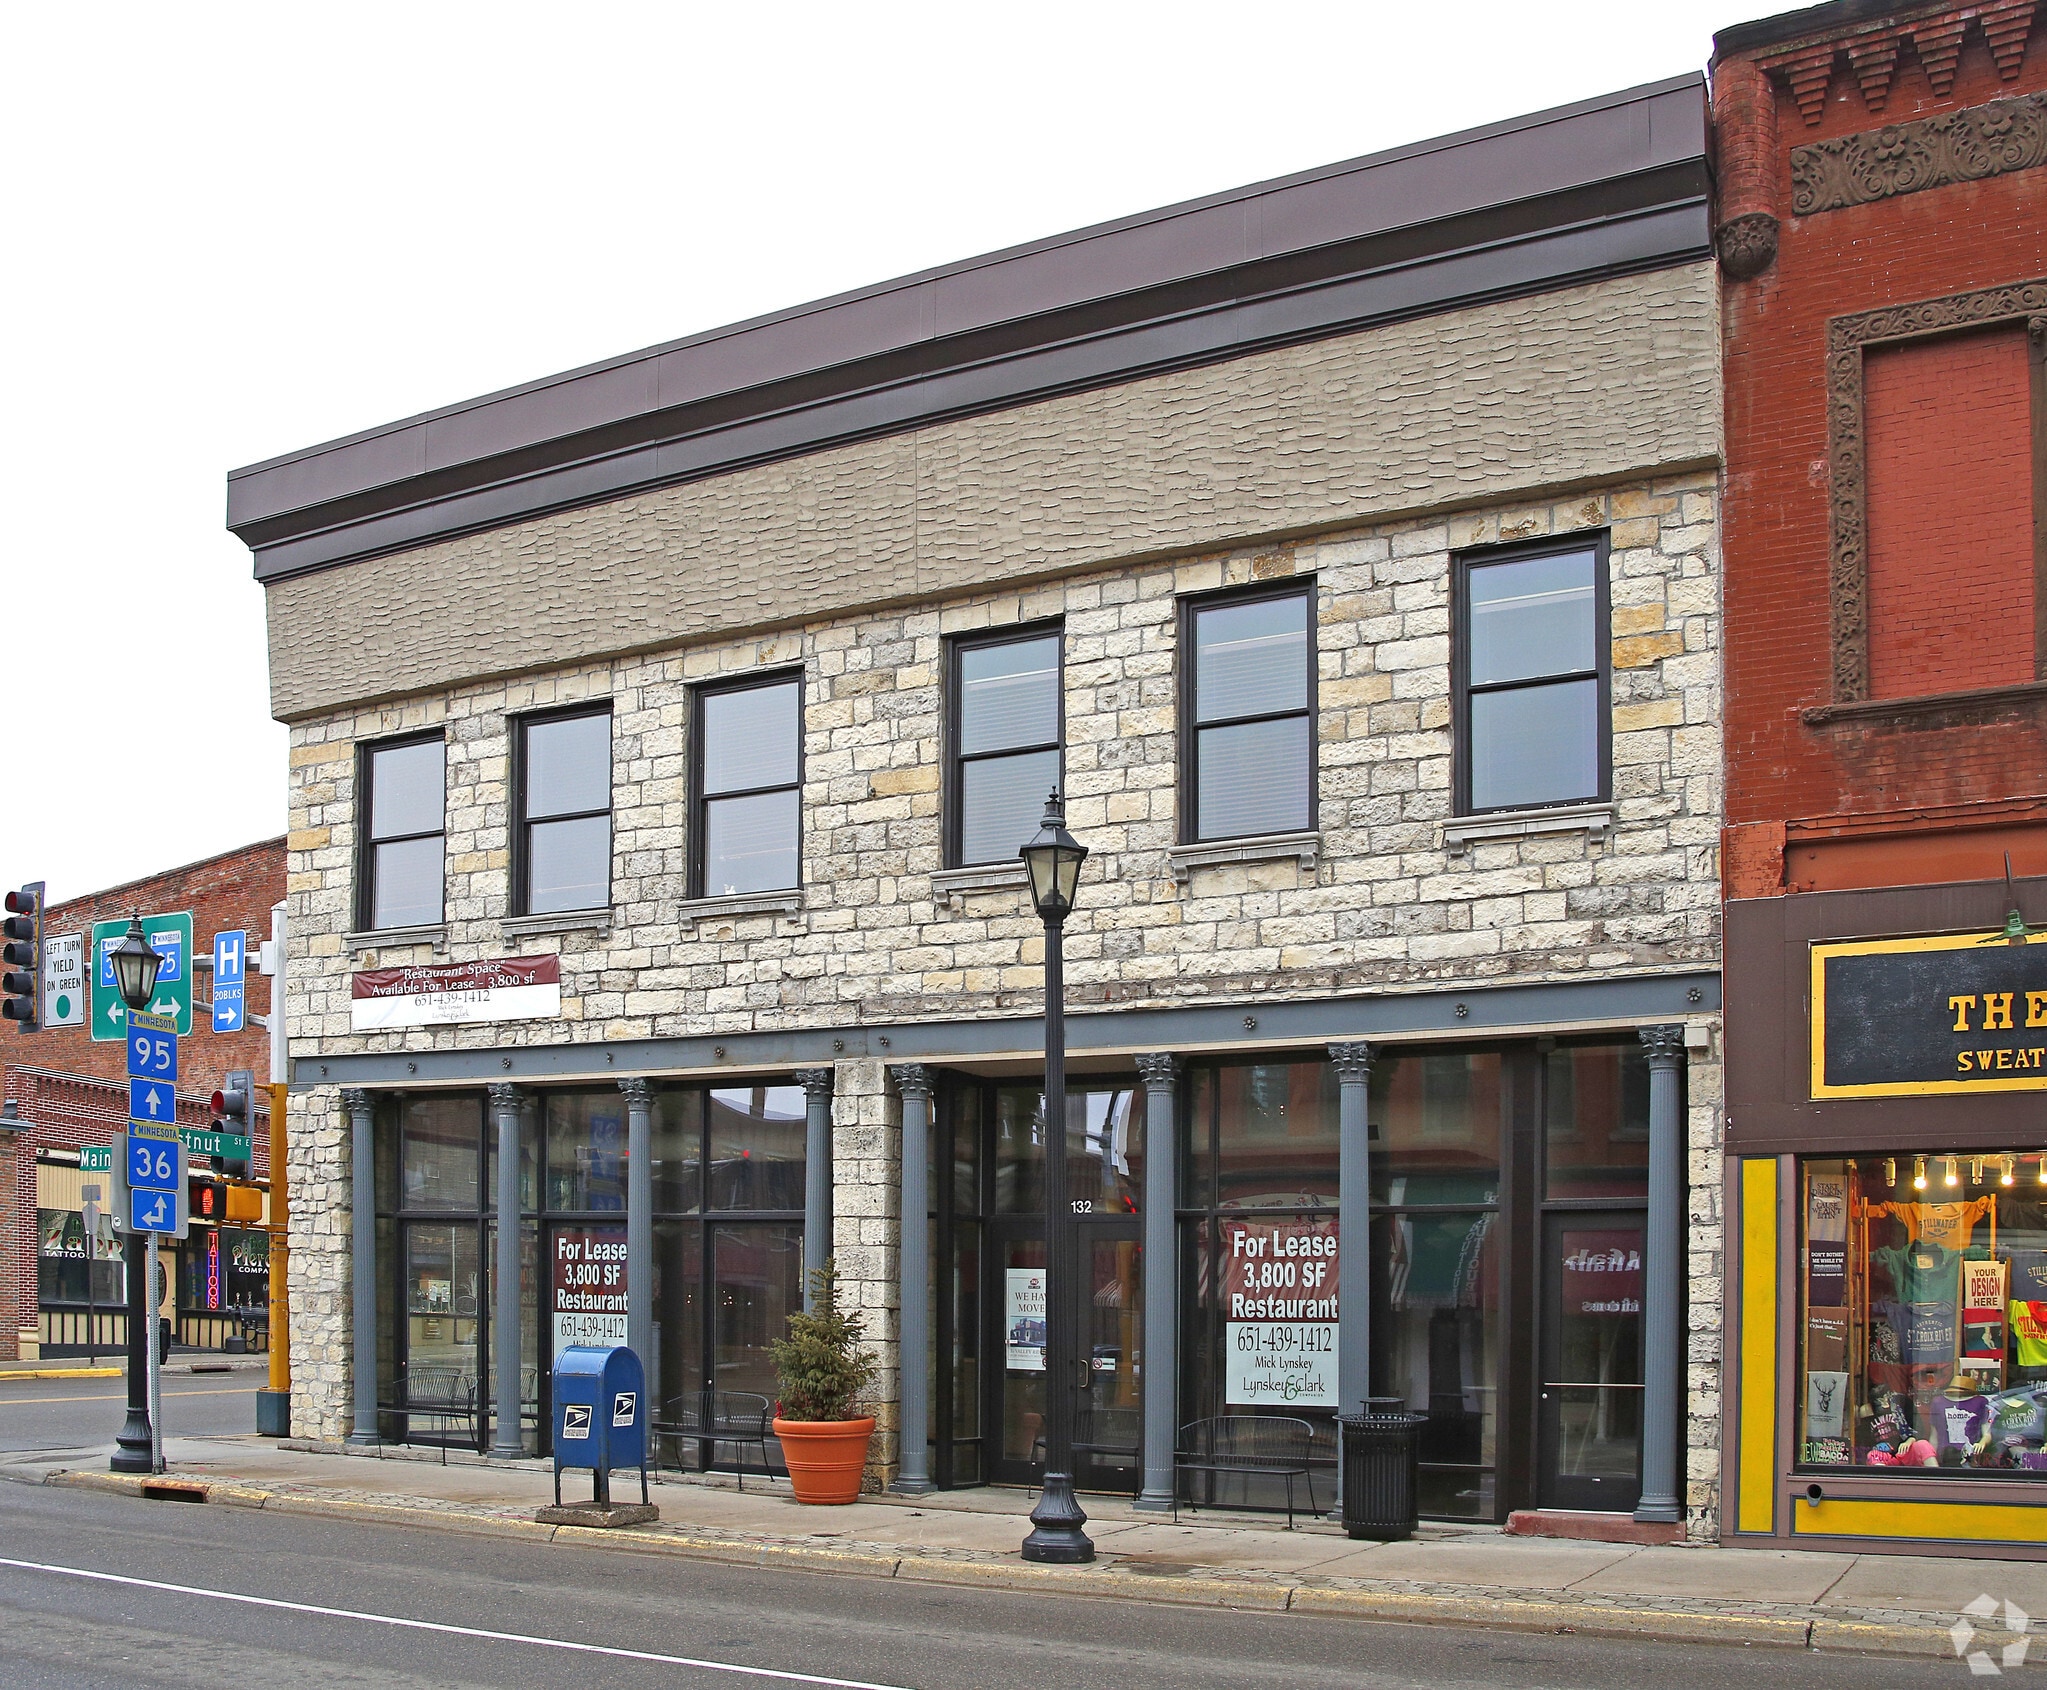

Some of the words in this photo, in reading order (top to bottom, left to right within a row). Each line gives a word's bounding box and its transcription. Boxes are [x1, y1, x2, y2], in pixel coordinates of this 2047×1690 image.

[46, 942, 61, 955] LEFT
[64, 940, 81, 952] TURN
[52, 958, 74, 973] YIELD
[219, 938, 239, 976] H
[46, 980, 56, 992] ON
[59, 977, 81, 991] GREEN
[371, 980, 419, 996] Available
[423, 980, 441, 992] For
[445, 977, 474, 991] Lease
[488, 975, 520, 988] 3,800
[524, 970, 536, 984] sf
[214, 989, 242, 1001] 20BLKS
[415, 990, 490, 1007] 651-439-1412
[1948, 990, 2047, 1032] THE
[137, 1015, 176, 1030] MINNESOTA
[135, 1037, 171, 1070] 95
[1957, 1047, 2045, 1072] SWEAT
[138, 1125, 177, 1139] MINNESOTA
[234, 1137, 242, 1146] St
[245, 1138, 250, 1147] E
[80, 1149, 111, 1167] Main
[135, 1147, 171, 1179] 36
[1070, 1200, 1092, 1214] 132
[1919, 1218, 1958, 1230] STILLWATER
[558, 1237, 581, 1260] For
[584, 1238, 628, 1261] Lease
[1233, 1230, 1267, 1258] For
[1273, 1230, 1337, 1257] Lease
[44, 1249, 91, 1260] TATTOO
[208, 1232, 218, 1310] TATTOOS
[565, 1263, 600, 1290] 3,800
[604, 1264, 621, 1286] SF
[1243, 1261, 1296, 1293] 3,800
[1302, 1261, 1327, 1288] SF
[1974, 1268, 1997, 1277] YOUR
[1971, 1277, 2001, 1297] DESIGN
[557, 1288, 628, 1311] Restaurant
[1015, 1292, 1029, 1301] WE
[1231, 1293, 1338, 1318] Restaurant
[1973, 1297, 1998, 1307] HERE
[561, 1316, 625, 1338] 651-439-1412
[1237, 1326, 1332, 1352] 651-439-1412
[1255, 1355, 1276, 1368] Mick
[1279, 1355, 1313, 1373] Lynskey
[1947, 1412, 1971, 1420] home.
